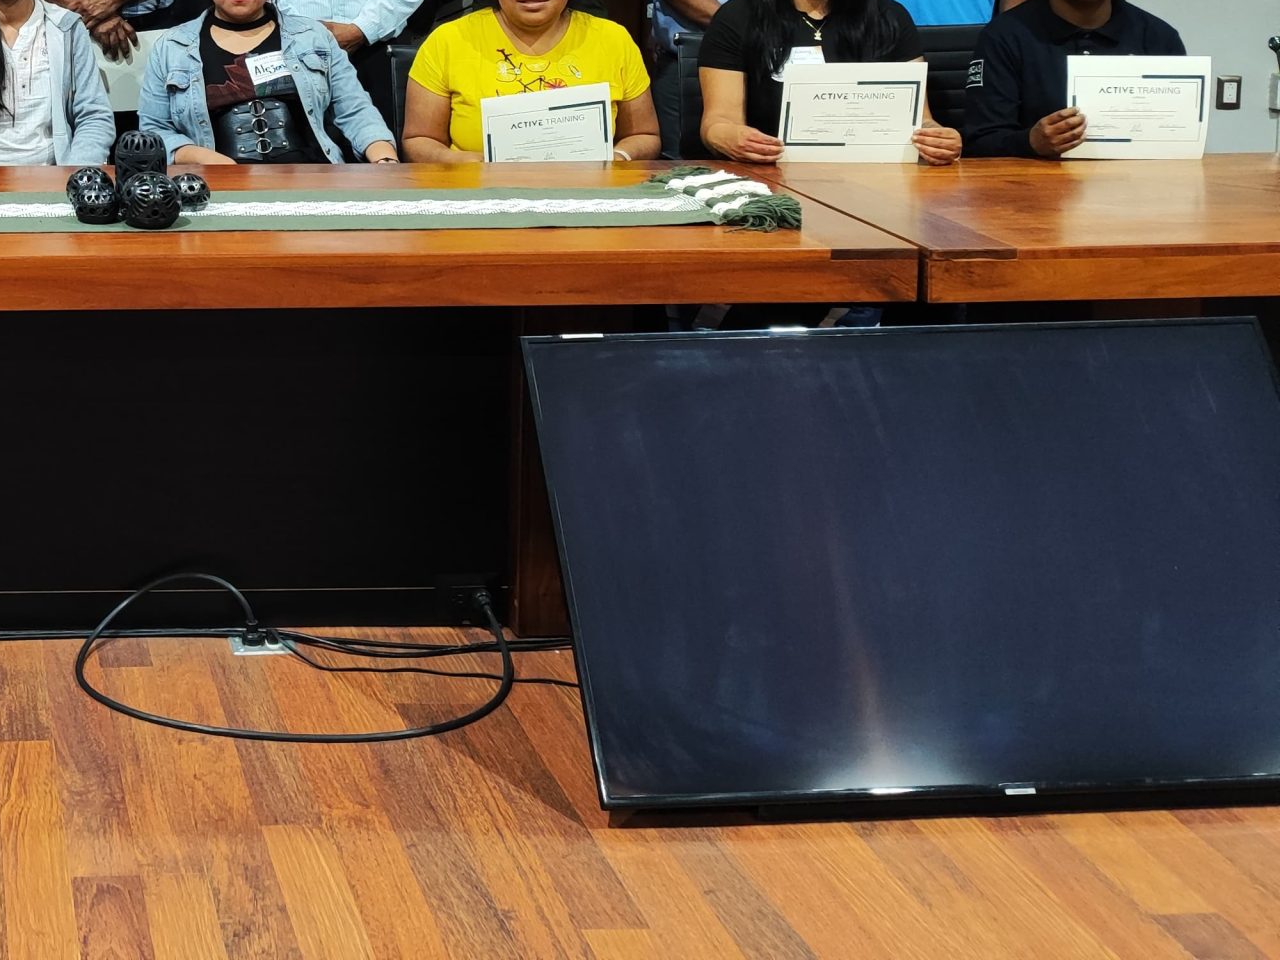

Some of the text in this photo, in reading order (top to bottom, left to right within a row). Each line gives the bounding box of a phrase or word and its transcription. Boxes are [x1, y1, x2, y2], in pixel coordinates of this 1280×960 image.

[1098, 86, 1182, 95] ACTIVE TRAINING
[813, 92, 896, 100] ACTIVE TRAINING
[510, 113, 585, 130] ACTIVE TRAINING
